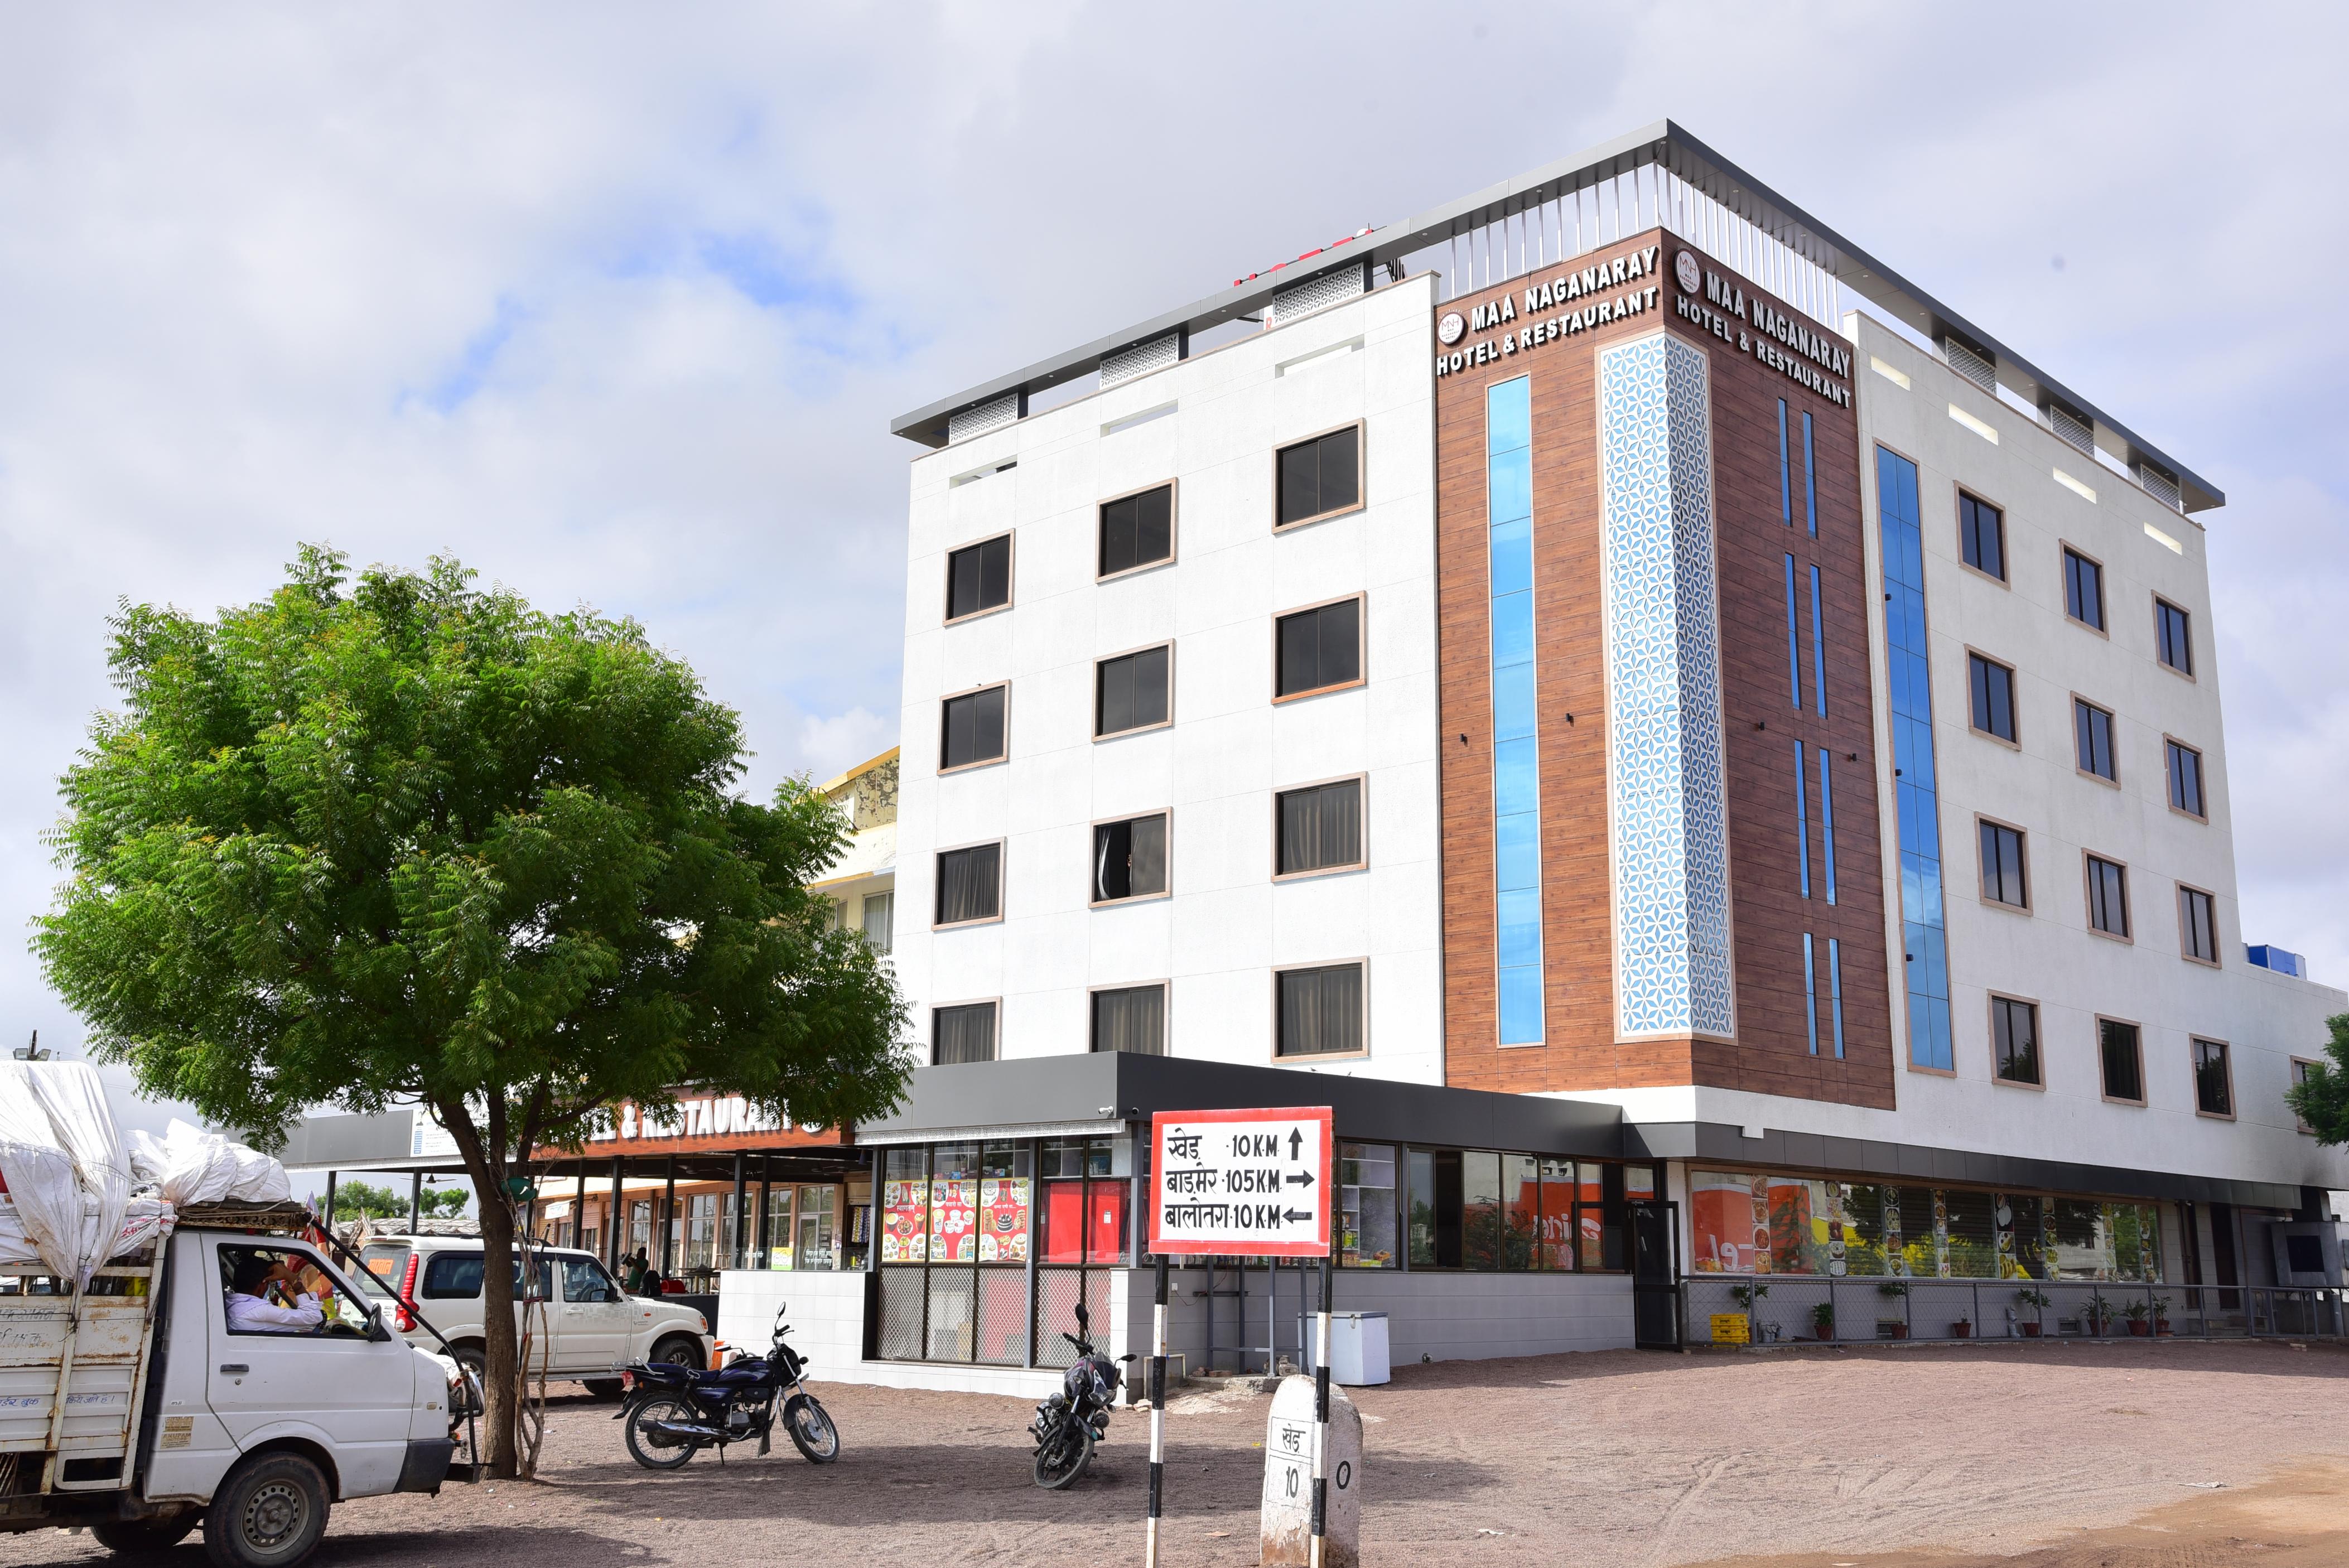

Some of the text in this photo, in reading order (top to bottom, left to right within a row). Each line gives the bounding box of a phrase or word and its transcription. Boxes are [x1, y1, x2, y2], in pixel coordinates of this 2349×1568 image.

[1436, 286, 1657, 375] HOTEL & RESTAURANT
[1472, 246, 1656, 331] MAA NAGANARAY
[1705, 271, 1850, 379] MAA NAGANARAY
[1677, 295, 1850, 408] HOTEL & RESTAURANT
[621, 1105, 638, 1139] &
[1165, 1197, 1229, 1229] बालोतरा
[1286, 1465, 1299, 1498] 10
